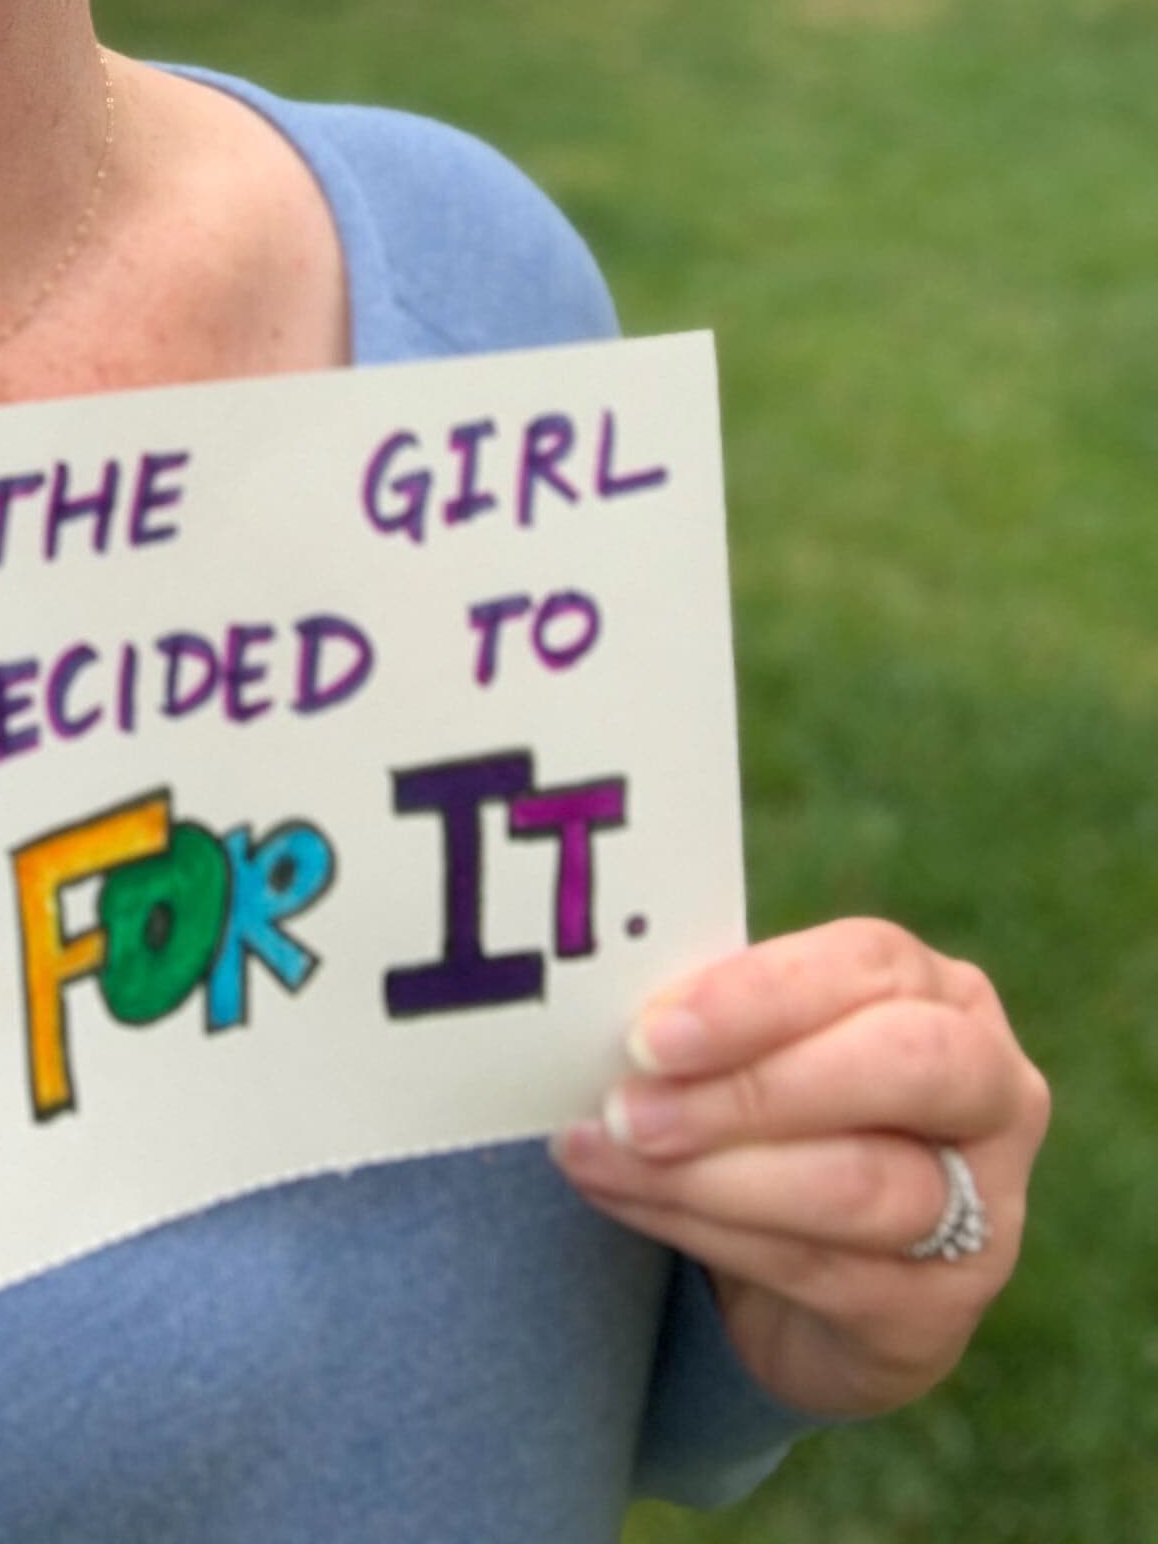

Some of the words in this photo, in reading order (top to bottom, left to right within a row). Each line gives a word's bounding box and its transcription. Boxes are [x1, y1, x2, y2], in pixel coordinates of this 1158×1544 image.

[362, 410, 668, 544] GIRL
[469, 592, 600, 686] TO
[10, 785, 336, 1124] FOR
[384, 748, 650, 1020] IT.
